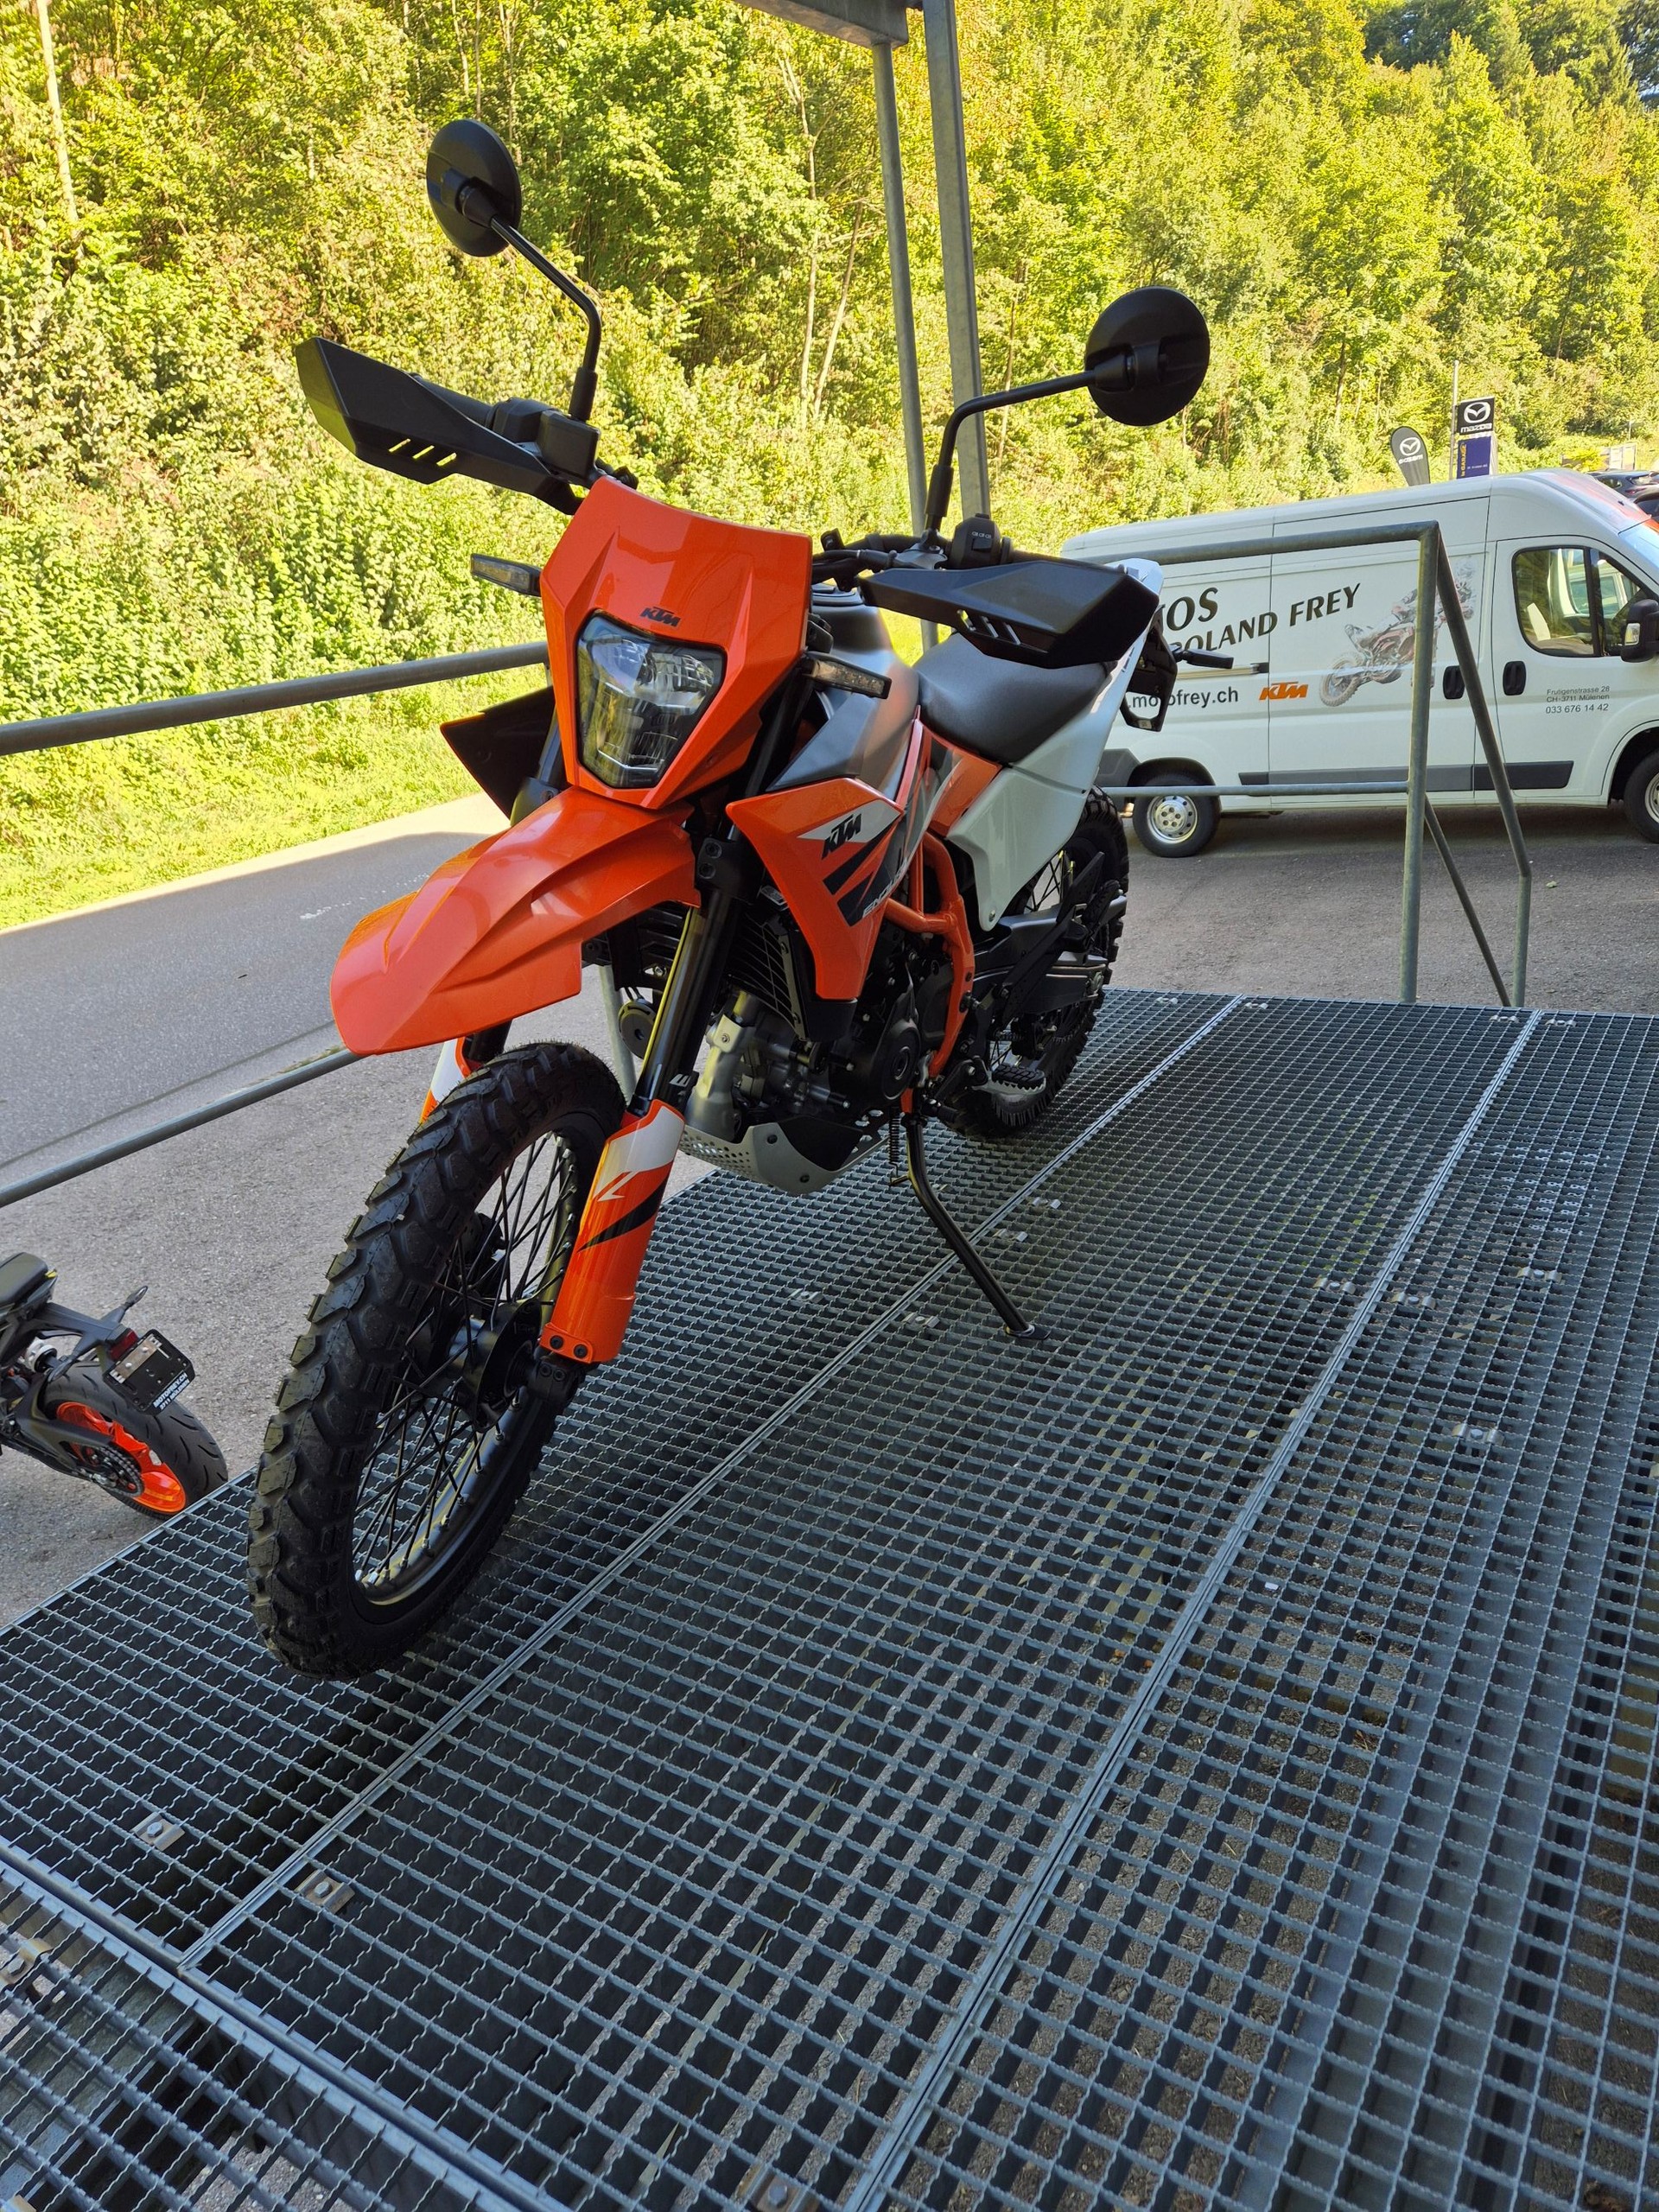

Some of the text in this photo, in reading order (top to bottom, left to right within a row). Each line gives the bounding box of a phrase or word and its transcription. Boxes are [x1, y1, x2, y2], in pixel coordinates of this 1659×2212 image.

[640, 607, 681, 626] KTM
[1289, 582, 1361, 627] FREY
[1259, 682, 1308, 701] KTM
[822, 813, 862, 860] KTM
